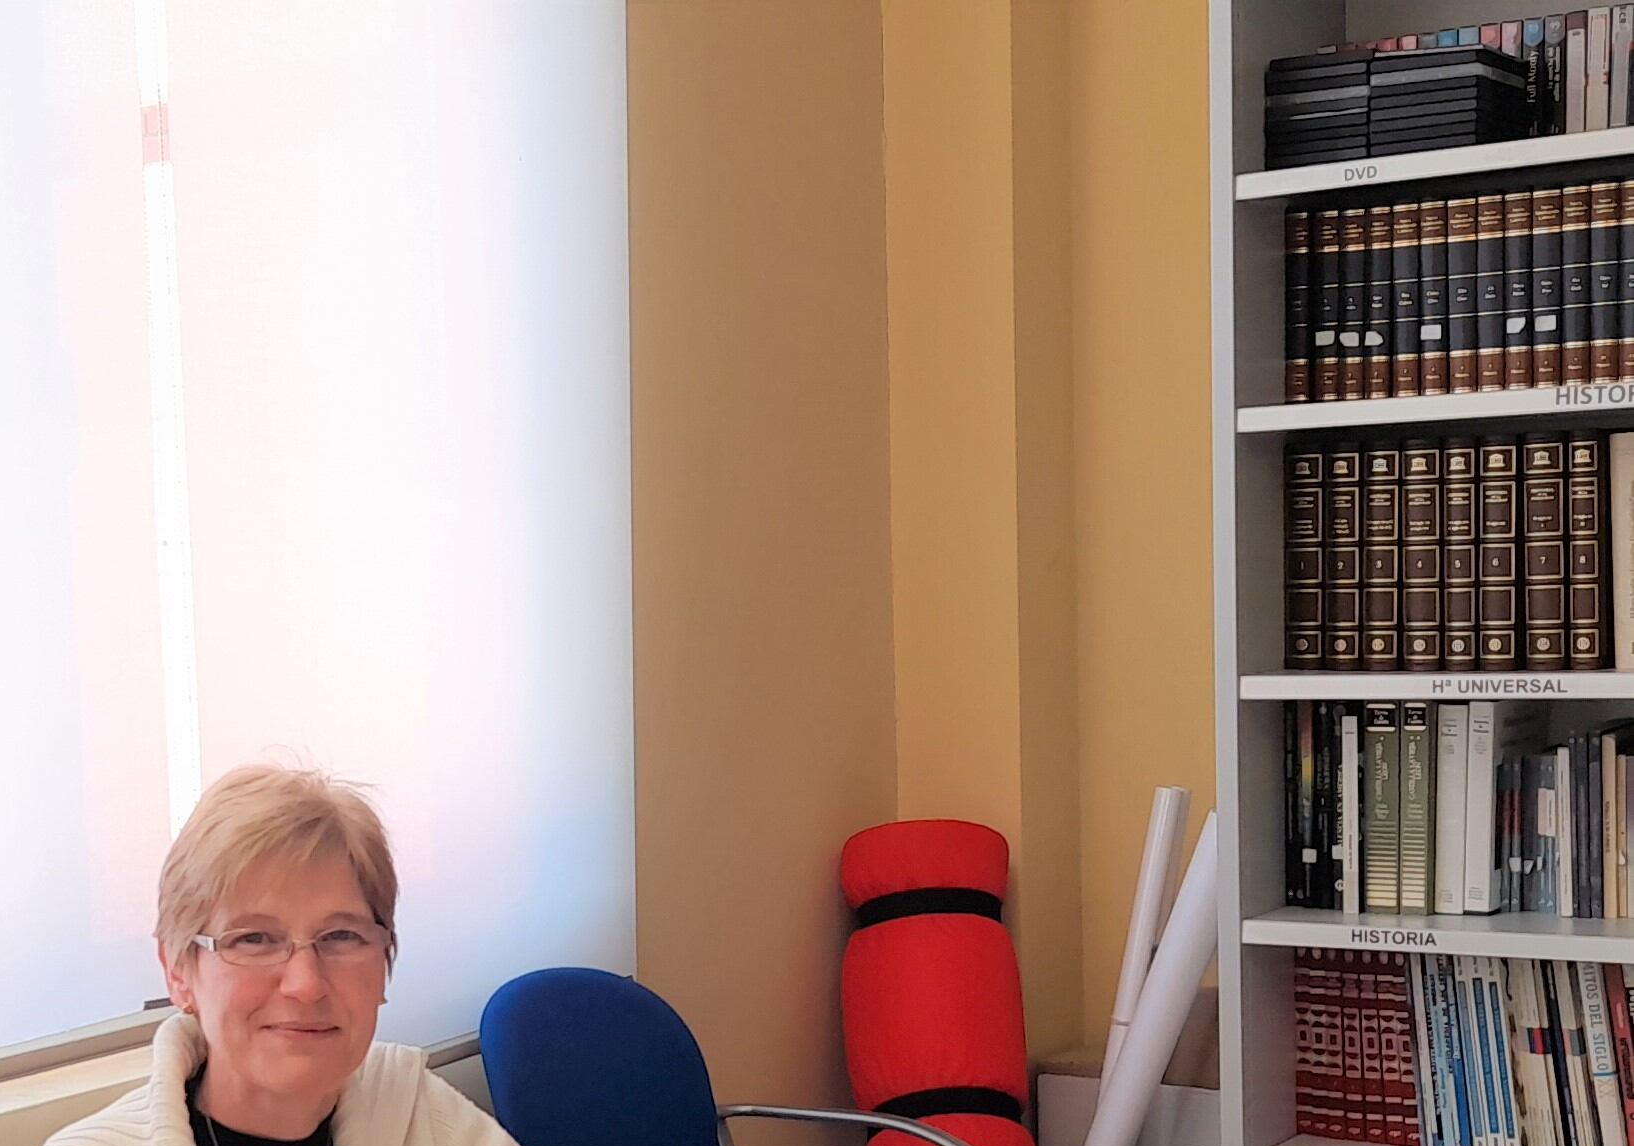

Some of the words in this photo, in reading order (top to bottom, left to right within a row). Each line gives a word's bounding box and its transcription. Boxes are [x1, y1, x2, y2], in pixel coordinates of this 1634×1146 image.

[1344, 165, 1378, 182] DVD
[1374, 559, 1382, 569] 3
[1416, 559, 1423, 569] 4
[1454, 558, 1461, 568] 5
[1492, 556, 1499, 566] 6
[1539, 555, 1546, 565] 7
[1579, 554, 1586, 564] 8
[1299, 561, 1305, 570] 1
[1336, 560, 1344, 570] 2
[1457, 679, 1568, 694] UNIVERSAL
[1351, 929, 1437, 946] HISTORIA
[1590, 1002, 1603, 1027] DEL
[1592, 1032, 1611, 1072] SIGLO
